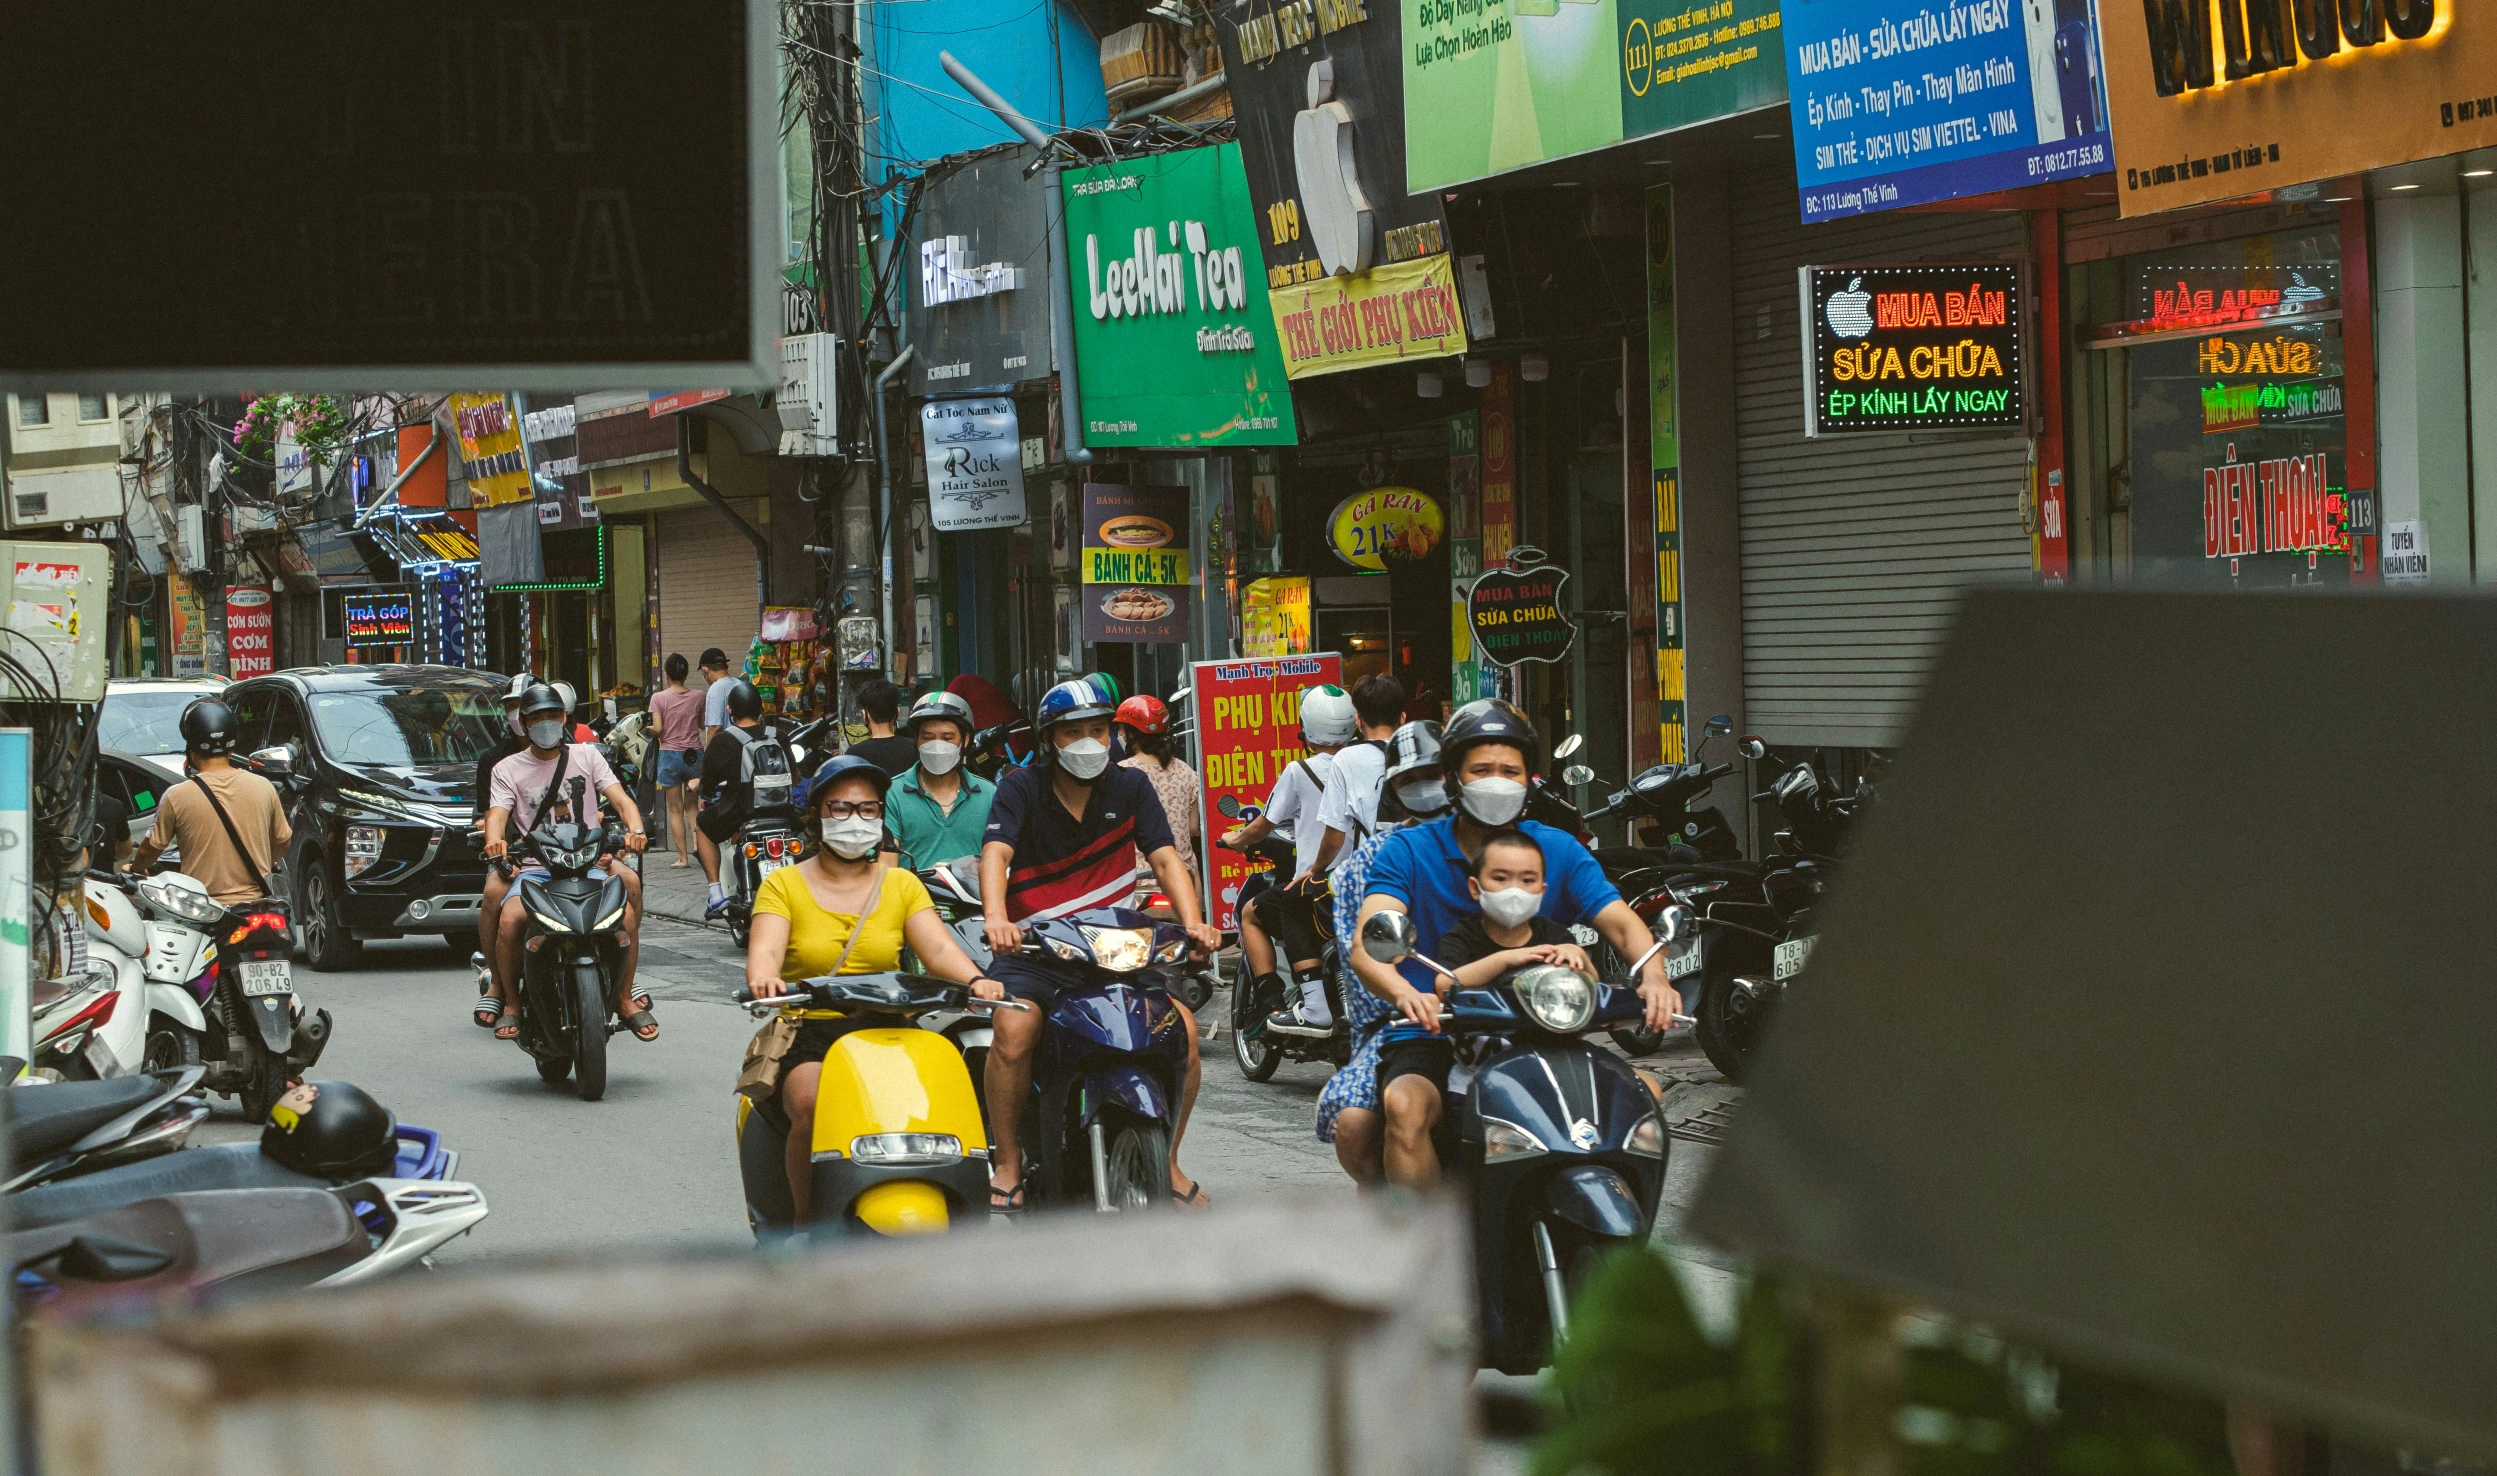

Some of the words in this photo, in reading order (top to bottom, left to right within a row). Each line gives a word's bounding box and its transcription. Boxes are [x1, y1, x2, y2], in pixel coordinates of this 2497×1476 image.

[1420, 4, 1434, 31] Độ
[1653, 18, 1677, 38] LƯƠNG
[1677, 6, 1691, 31] THẾ
[1416, 43, 1433, 70] Lựa
[1434, 35, 1460, 62] Chọn
[1462, 23, 1489, 53] Hoàn
[1799, 39, 1831, 76] MUA
[1832, 27, 1861, 67] BÁN
[1869, 17, 1899, 60] SỬA
[1900, 9, 1940, 46] CHỮA
[1970, 0, 2010, 36] NGAY
[1628, 43, 1649, 71] 111
[1807, 92, 1824, 131] Ép
[1826, 86, 1853, 122] Kính
[1861, 83, 1891, 118] Thay
[1892, 80, 1914, 107] Pin
[1922, 72, 1953, 105] Thay
[1956, 66, 1984, 96] Màn
[1984, 56, 2017, 87] Hình
[1815, 146, 1836, 171] SIM
[1836, 131, 1859, 165] THẺ
[1866, 138, 1892, 166] DỊCH
[1893, 134, 1910, 160] VỤ
[1911, 127, 1931, 151] SIM
[1933, 116, 1982, 147] VIETTEL
[1988, 109, 2018, 140] VINA
[2027, 156, 2045, 177] ĐT:
[2045, 144, 2105, 173] 0812.77.55.88
[1806, 196, 1822, 214] ĐC:
[1822, 193, 1837, 211] 113
[1837, 187, 1862, 210] Lương
[1862, 182, 1880, 204] Thế
[1879, 184, 1899, 202] Vinh
[1268, 199, 1300, 245] 109
[1283, 288, 1321, 361] THẾ
[1320, 288, 1363, 355] GIỚI
[1360, 293, 1405, 357] PHỤ
[1402, 272, 1459, 352] KIỆN
[1877, 291, 1942, 328] MUA
[1945, 282, 2006, 327] BÁN
[1833, 341, 1906, 382] SỬA
[1909, 339, 2004, 379] CHỮA
[968, 406, 990, 417] Nam
[1830, 389, 1857, 416] ÉP
[1861, 387, 1908, 415] KÍNH
[1913, 386, 1950, 414] LẤY
[1955, 389, 2009, 413] NGAY
[2312, 384, 2342, 413] CHỮA
[942, 480, 970, 491] Hair
[973, 478, 1008, 489] Salon
[1352, 499, 1376, 522] GÀ
[1382, 493, 1427, 515] RÁN
[2043, 487, 2062, 539] SỬA
[2203, 443, 2258, 577] ĐIỆN
[2260, 453, 2329, 571] THOẠI
[2350, 498, 2373, 528] 113
[938, 519, 952, 527] 105
[1350, 521, 1398, 558] 21K
[1094, 548, 1131, 583] BÁNH
[1134, 548, 1157, 583] CÁ:
[1160, 554, 1178, 584] 5K
[1476, 587, 1514, 604] MUA
[227, 614, 245, 629] CƠM
[247, 612, 272, 628] SƯỜN
[348, 605, 376, 621] TRẢ
[379, 604, 409, 619] GÓP
[1477, 606, 1509, 627] SỬA
[1512, 603, 1557, 623] CHỮA
[232, 633, 268, 650] CƠM
[350, 623, 378, 636] Sinh
[381, 622, 410, 635] Viên
[1215, 663, 1250, 684] Mạnh
[1251, 662, 1278, 678] Trọc
[1281, 659, 1322, 676] Mobile
[1214, 695, 1263, 736] PHỤ
[1207, 746, 1265, 794] ĐIỆN
[1221, 862, 1241, 878] Rẻ
[246, 977, 292, 994] 206.49
[248, 963, 285, 978] 90-B2
